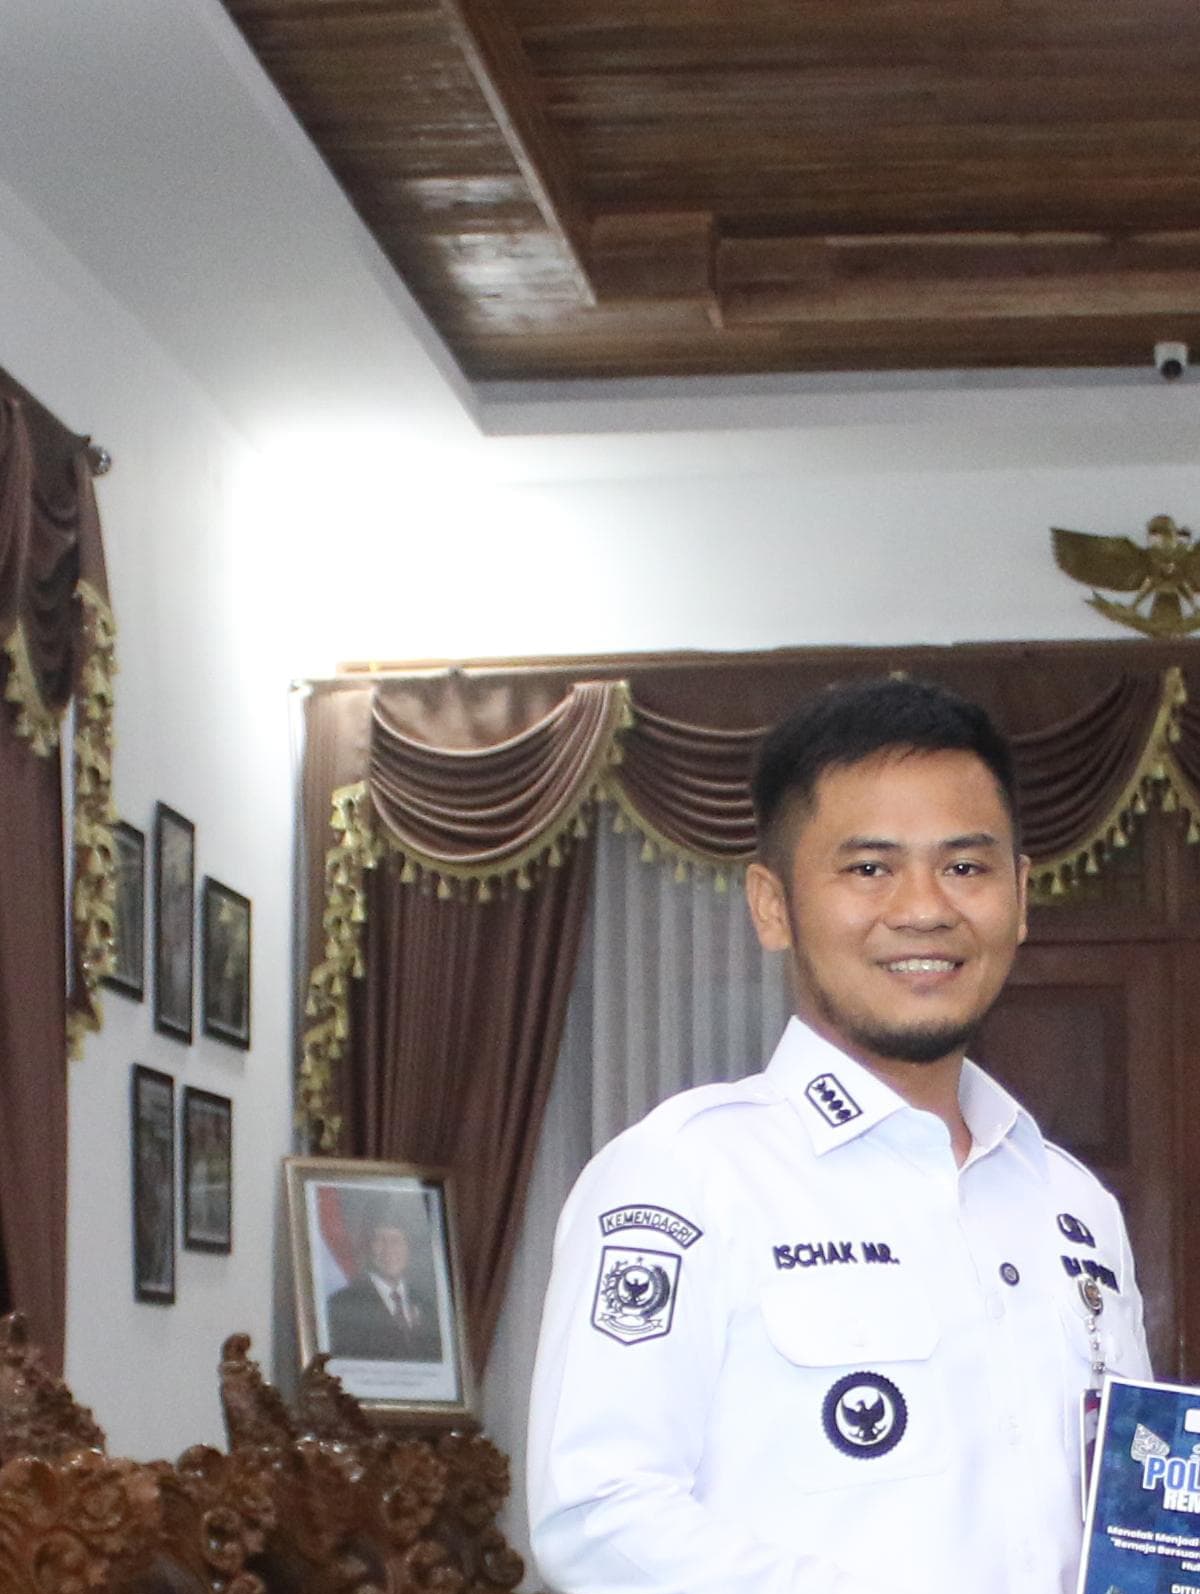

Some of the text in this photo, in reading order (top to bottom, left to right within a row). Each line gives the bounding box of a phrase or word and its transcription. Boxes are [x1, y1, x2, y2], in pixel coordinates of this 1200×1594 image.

[606, 1211, 692, 1242] KEMENDAGRI
[772, 1241, 858, 1270] ISCHAK
[1155, 1533, 1200, 1547] Menjadi
